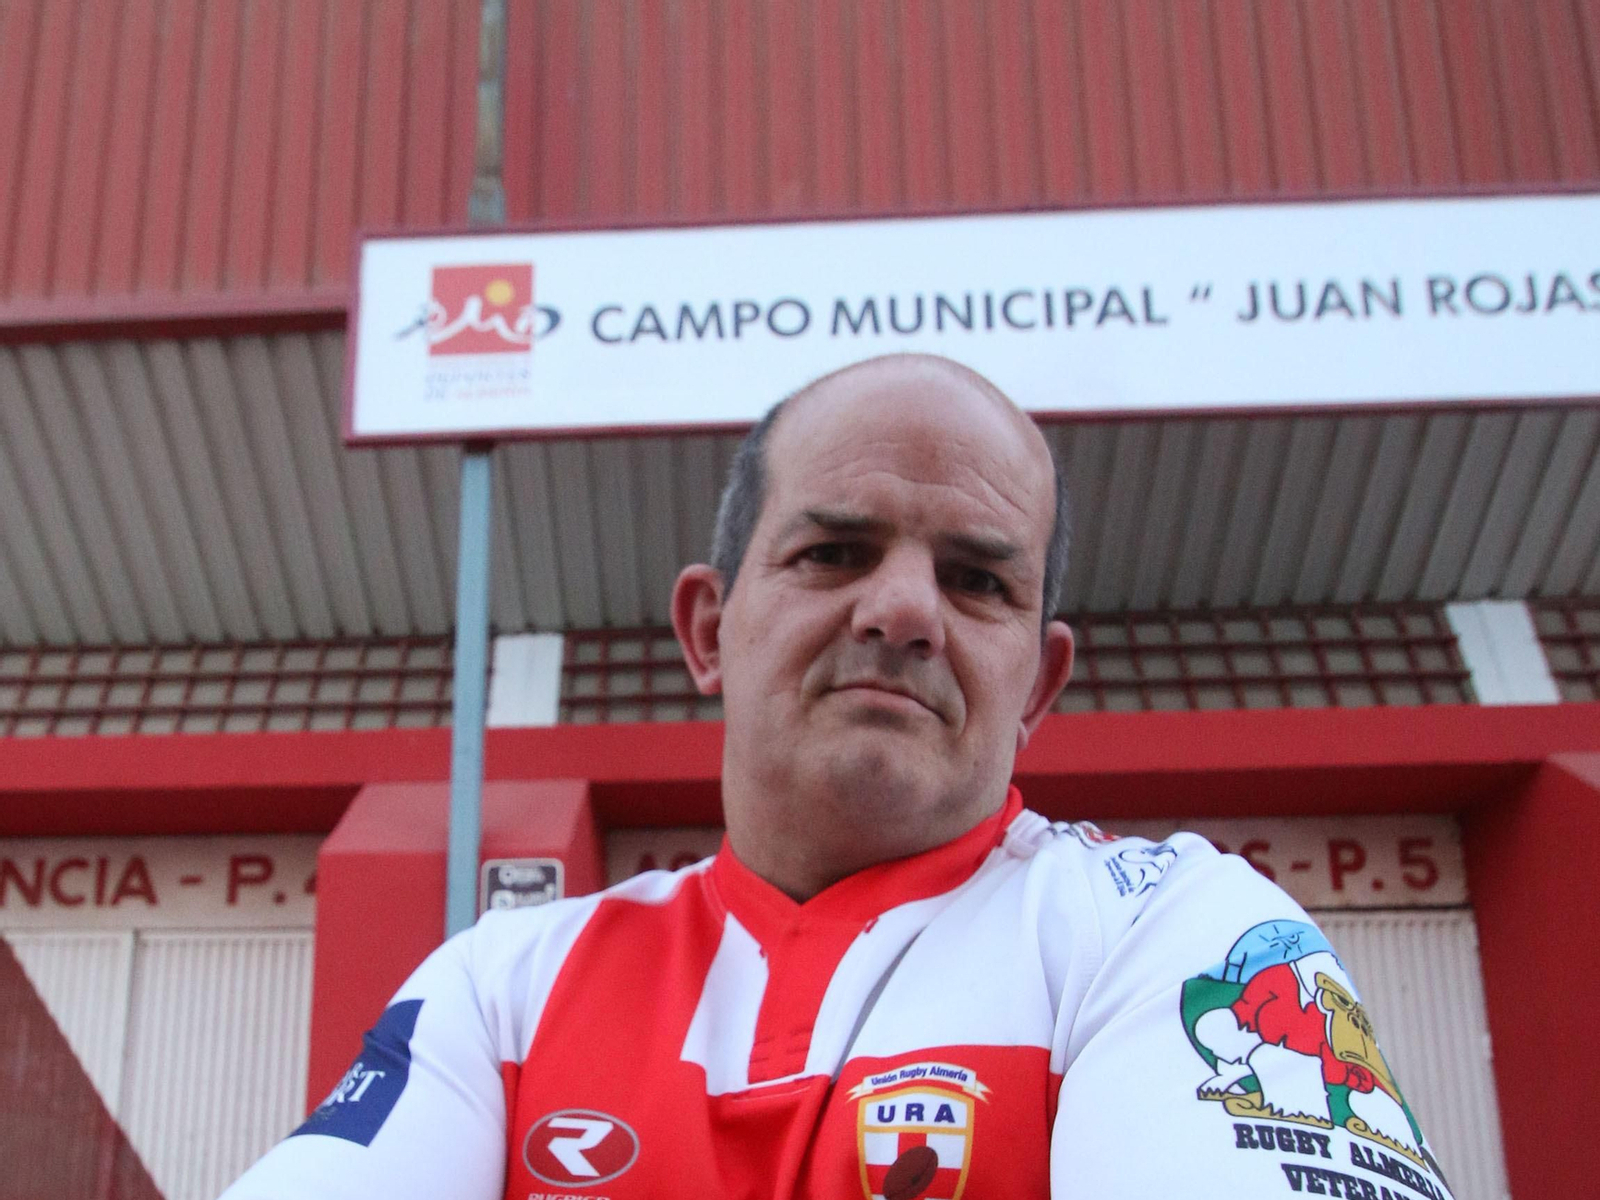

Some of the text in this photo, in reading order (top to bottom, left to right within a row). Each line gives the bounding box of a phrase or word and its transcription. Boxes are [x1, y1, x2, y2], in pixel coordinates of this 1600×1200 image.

[590, 299, 811, 343] CAMPO
[830, 286, 1168, 336] MUNICIPAL
[1237, 277, 1403, 323] JUAN
[900, 1067, 928, 1079] Rugby
[930, 1066, 967, 1082] Almería
[1233, 1123, 1333, 1159] RUGBY
